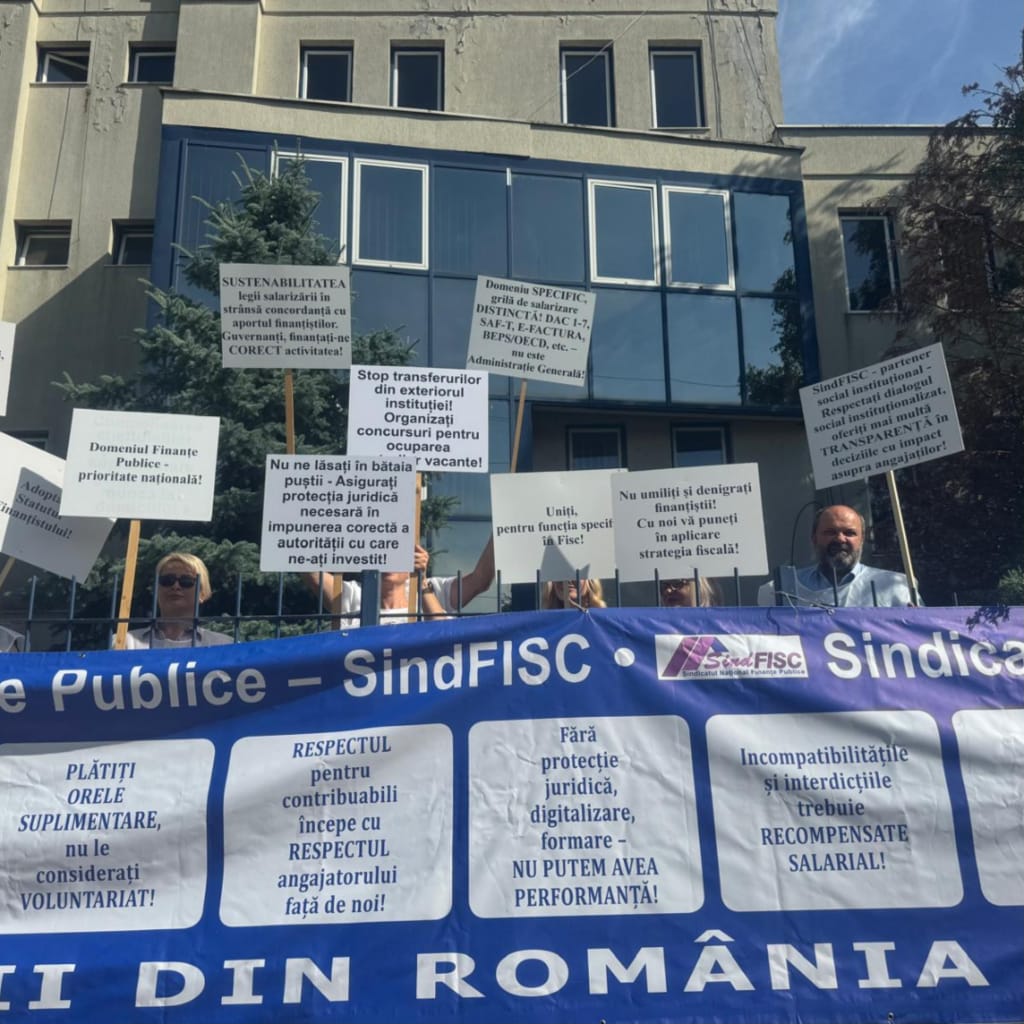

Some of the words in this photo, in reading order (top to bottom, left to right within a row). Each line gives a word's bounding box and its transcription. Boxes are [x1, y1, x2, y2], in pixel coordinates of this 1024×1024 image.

[358, 370, 389, 383] Stop
[393, 372, 481, 384] transferurilor
[375, 384, 395, 394] din
[400, 386, 464, 397] exteriorul
[386, 398, 452, 413] instituției!
[384, 412, 453, 428] Organizați
[357, 428, 431, 438] concursuri
[436, 430, 479, 440] pentru
[90, 442, 148, 454] Domeniul
[153, 445, 198, 458] Finanțe
[386, 442, 450, 454] ocuparea
[116, 457, 160, 468] Publice
[271, 460, 289, 470] Nu
[294, 462, 310, 470] ne
[315, 460, 350, 474] lăsați
[356, 460, 367, 471] în
[372, 461, 412, 472] bătaia
[425, 457, 482, 467] vacante!
[78, 470, 137, 482] prioritate
[141, 473, 202, 484] națională!
[285, 475, 322, 489] puștii
[336, 475, 397, 490] Asigurați
[282, 491, 343, 504] protecția
[347, 491, 398, 504] juridică
[300, 507, 362, 517] necesară
[368, 506, 379, 517] în
[269, 521, 342, 534] impunerea
[346, 522, 397, 533] corectă
[402, 525, 409, 533] a
[278, 537, 344, 552] autorității
[349, 540, 364, 548] cu
[370, 540, 398, 549] care
[288, 553, 327, 567] ne-ați
[332, 553, 386, 564] investit!
[53, 661, 266, 711] Publice
[343, 633, 591, 697] SindFISC
[740, 746, 909, 769] Incompatibilitățile
[764, 774, 778, 796] și
[784, 771, 892, 793] interdicțiile
[798, 799, 865, 817] trebuie
[761, 824, 909, 845] RECOMPENSATE
[789, 852, 885, 872] SALARIAL!
[135, 956, 350, 1007] DIN
[416, 930, 990, 1000] ROMÂNIA
